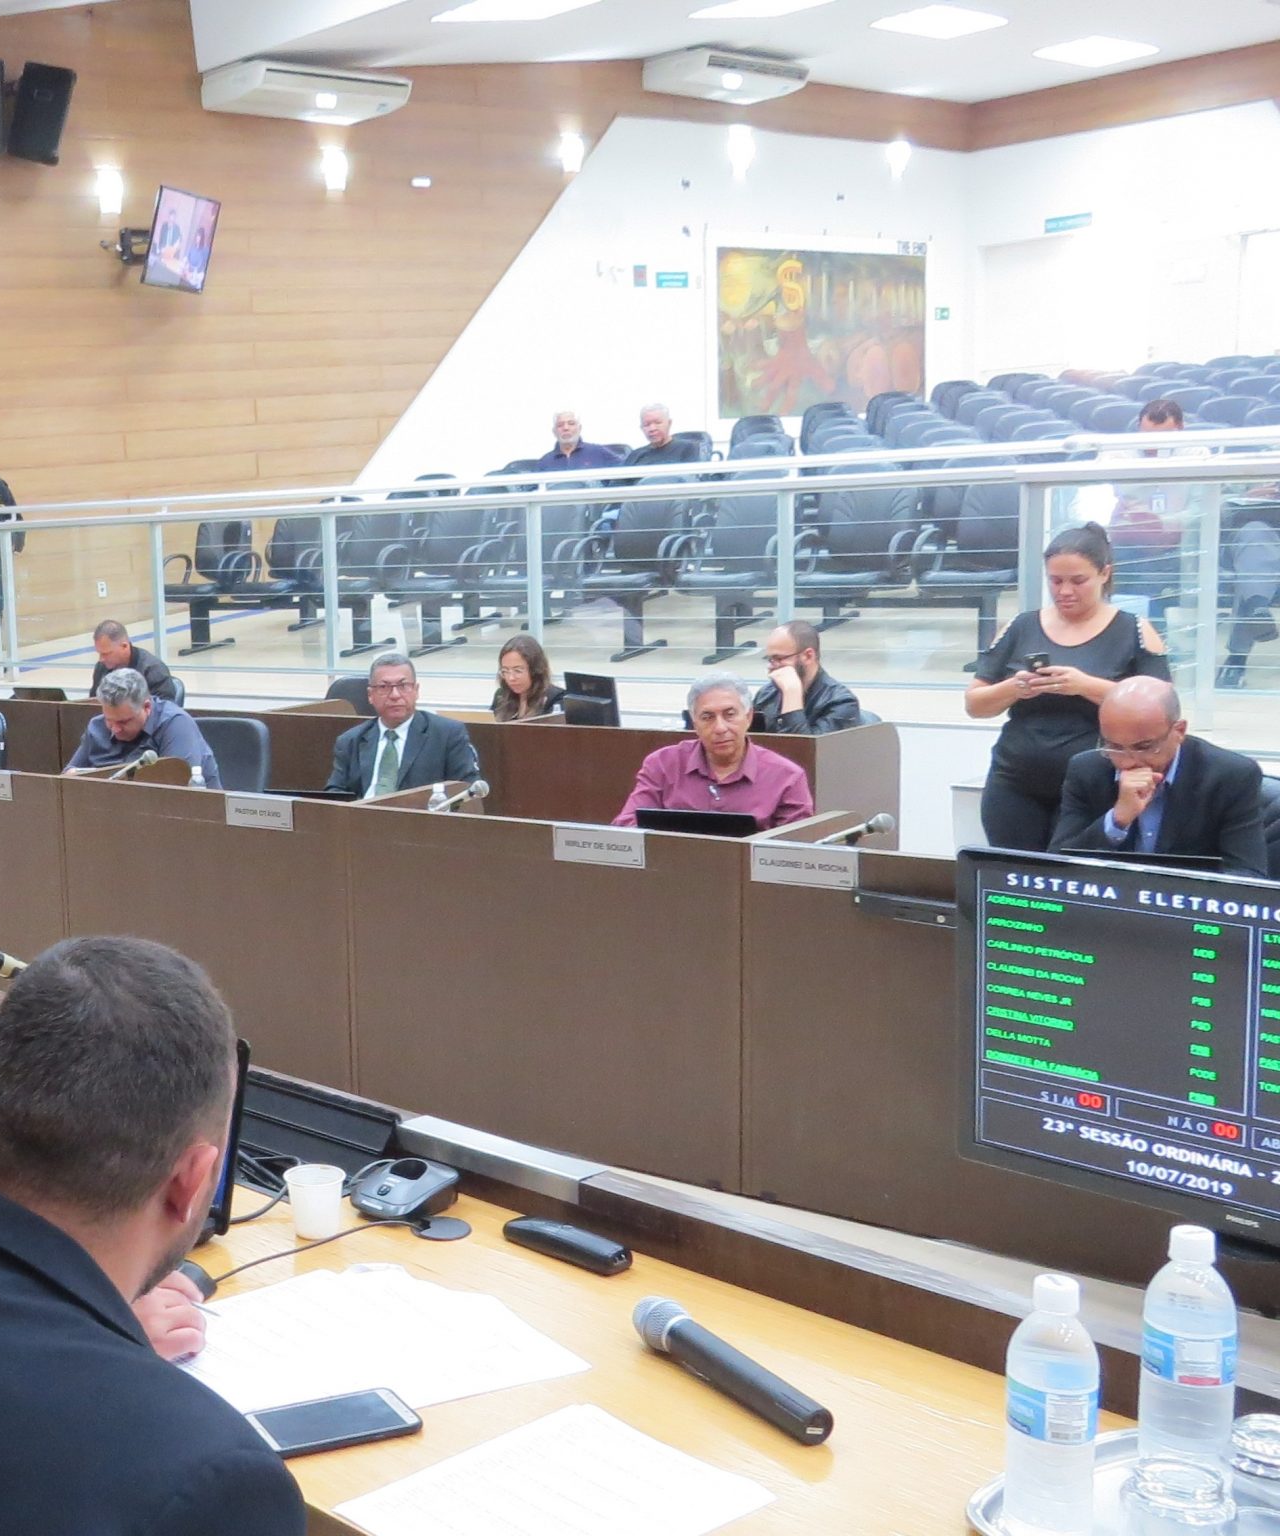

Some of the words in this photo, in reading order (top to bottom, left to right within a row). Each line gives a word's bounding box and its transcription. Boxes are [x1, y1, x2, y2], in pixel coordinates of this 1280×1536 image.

[234, 806, 258, 817] PASTOR
[593, 841, 605, 850] DE
[605, 842, 633, 853] SOUZA
[759, 857, 803, 870] CLAUDINEI
[804, 861, 817, 870] DA
[817, 862, 849, 874] ROCHA
[1006, 872, 1118, 900] SISTEMA
[986, 939, 1034, 954] CARLINHO
[986, 961, 1035, 978] CLAUDINEI
[1035, 969, 1050, 980] DA
[1050, 972, 1086, 986] ROCHA
[1017, 1033, 1052, 1048] MOTTA
[1040, 1090, 1075, 1107] SIM
[1078, 1092, 1103, 1109] 00
[1167, 1115, 1208, 1133] NÃO
[1212, 1121, 1239, 1140] 00
[1079, 1125, 1149, 1153] SESSÃO
[1151, 1142, 1253, 1178] ORDINÁRIA
[1126, 1159, 1234, 1196] 10/07/2019
